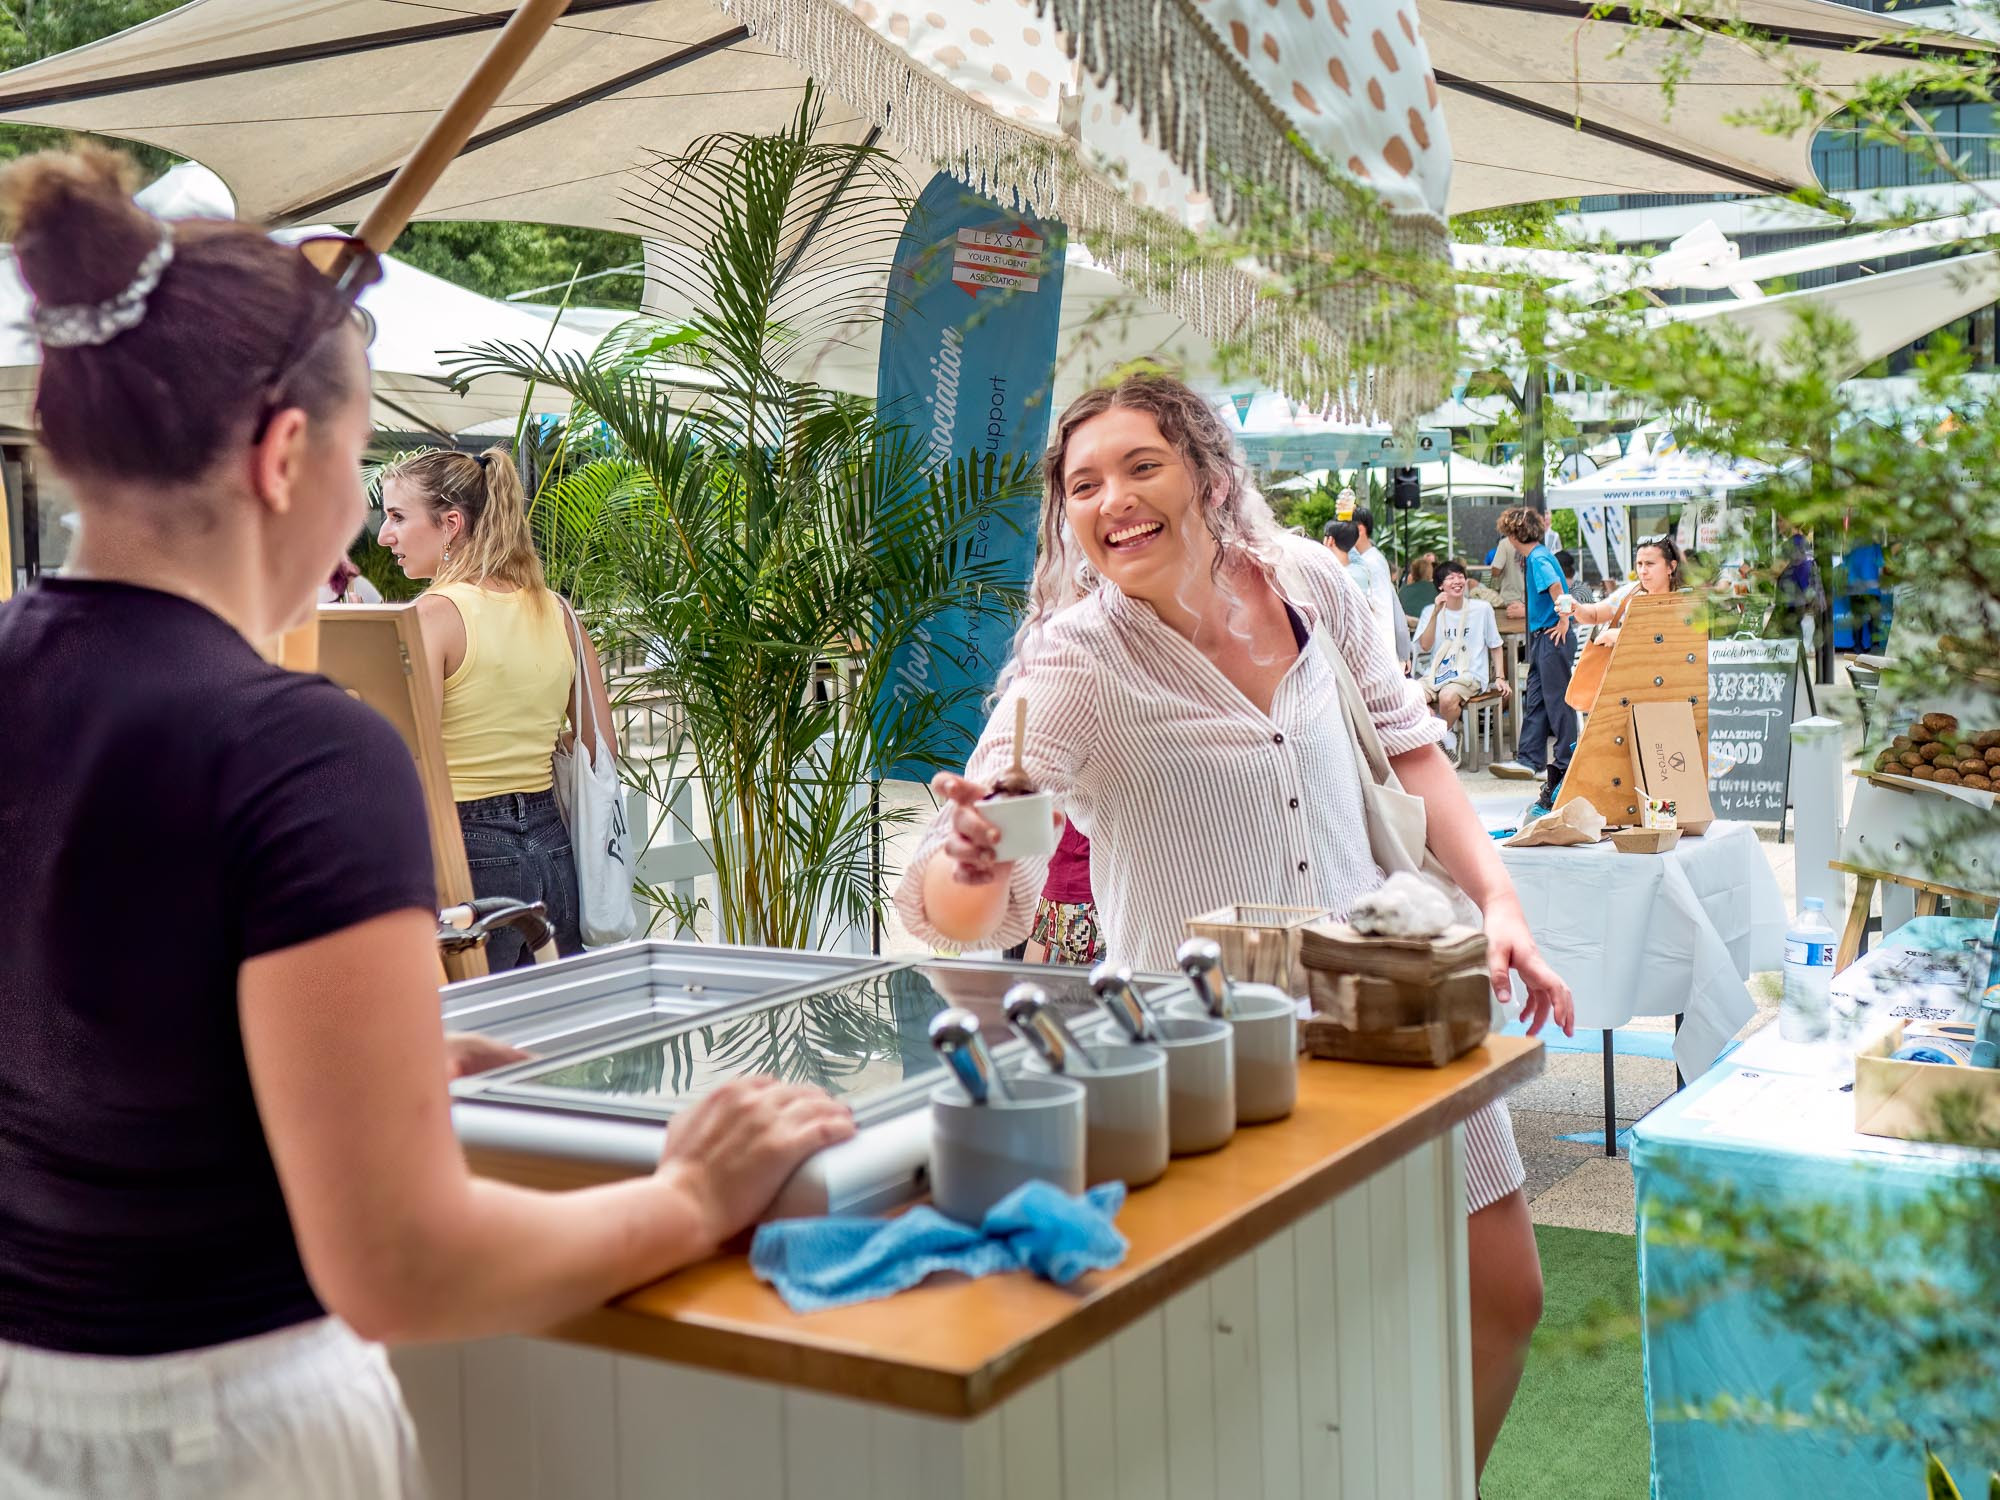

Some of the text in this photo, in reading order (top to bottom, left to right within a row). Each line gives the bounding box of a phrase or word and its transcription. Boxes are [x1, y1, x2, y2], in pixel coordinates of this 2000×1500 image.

[974, 231, 1024, 249] LEXSA
[968, 252, 1028, 268] YOUR STUDENT
[969, 272, 1022, 286] ASSOCIATION
[976, 375, 1007, 465] Support
[1712, 644, 1790, 661] quick brown fox
[1711, 729, 1762, 740] AMAZING
[1655, 743, 1669, 782] BUTORA
[1751, 780, 1784, 793] LOVE
[1720, 794, 1731, 810] by
